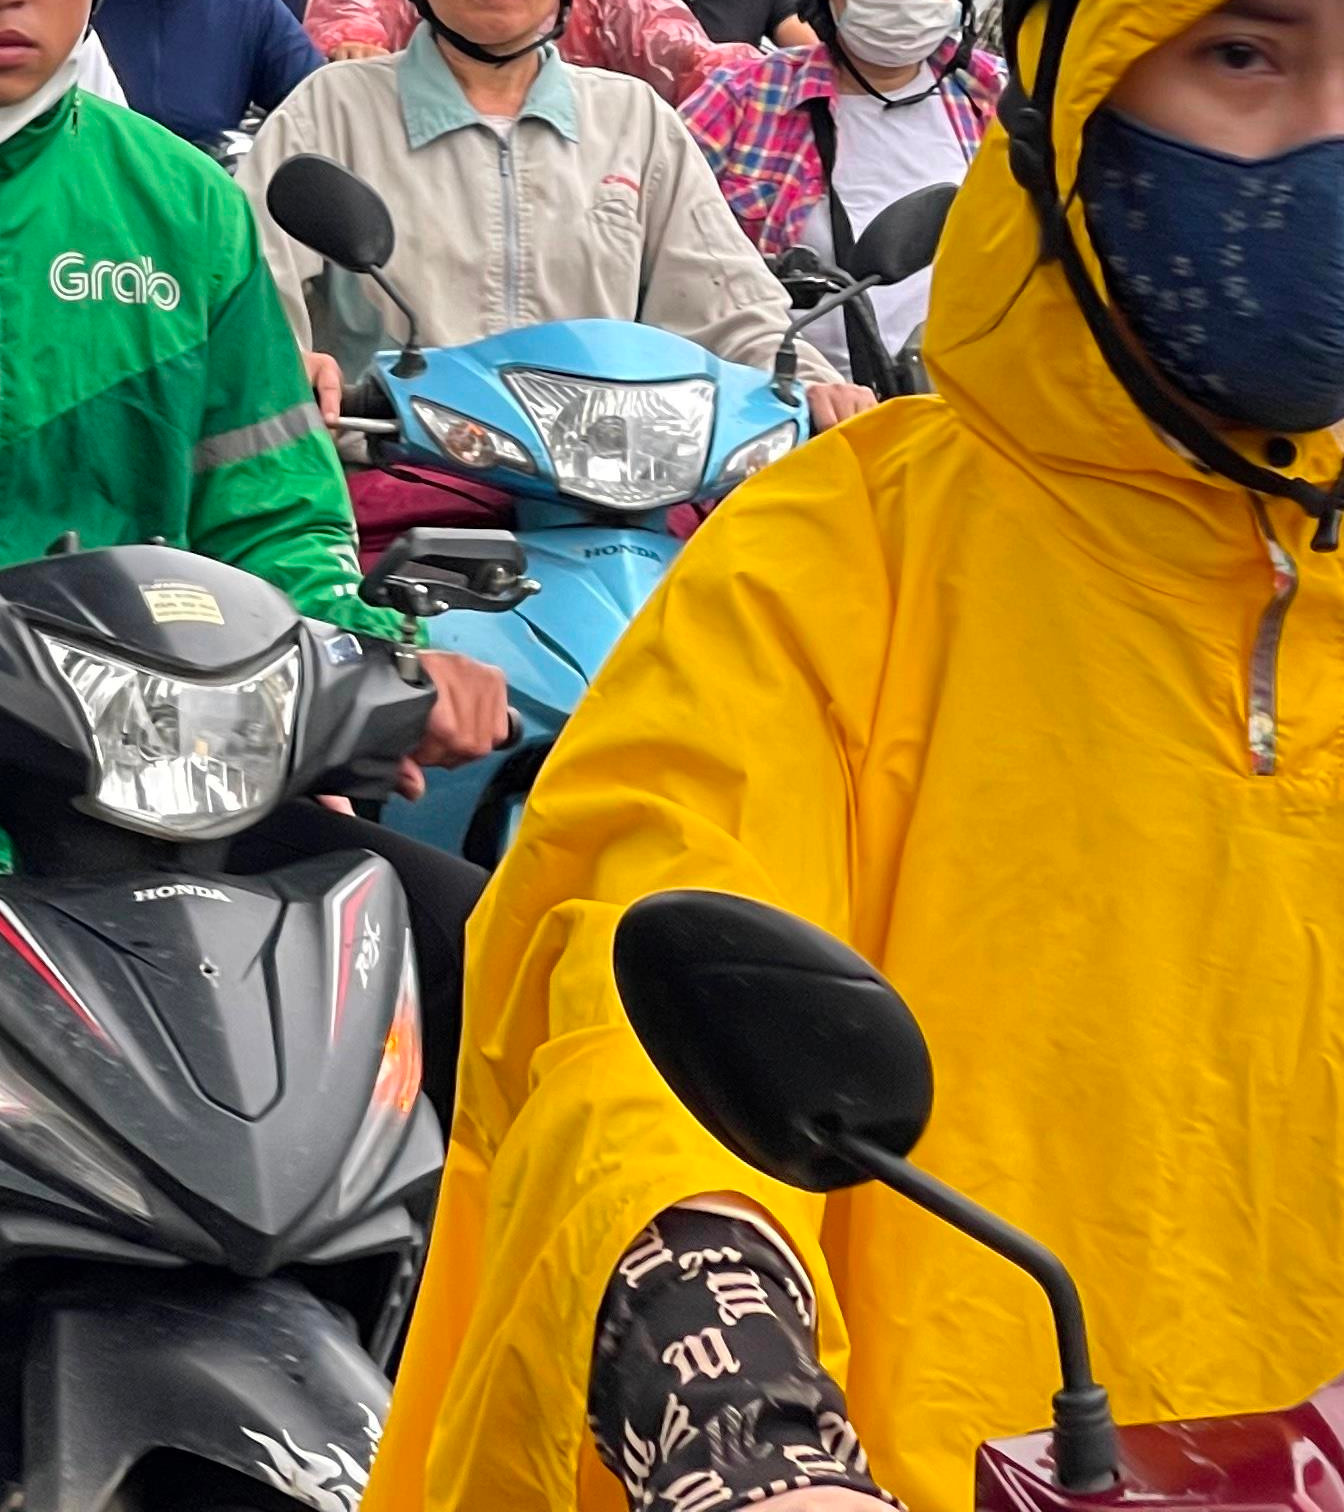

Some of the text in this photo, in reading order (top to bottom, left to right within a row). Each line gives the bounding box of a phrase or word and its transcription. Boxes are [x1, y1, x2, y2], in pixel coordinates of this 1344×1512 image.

[49, 251, 181, 311] Grab
[583, 543, 663, 563] HONDA
[132, 884, 233, 903] HONDA
